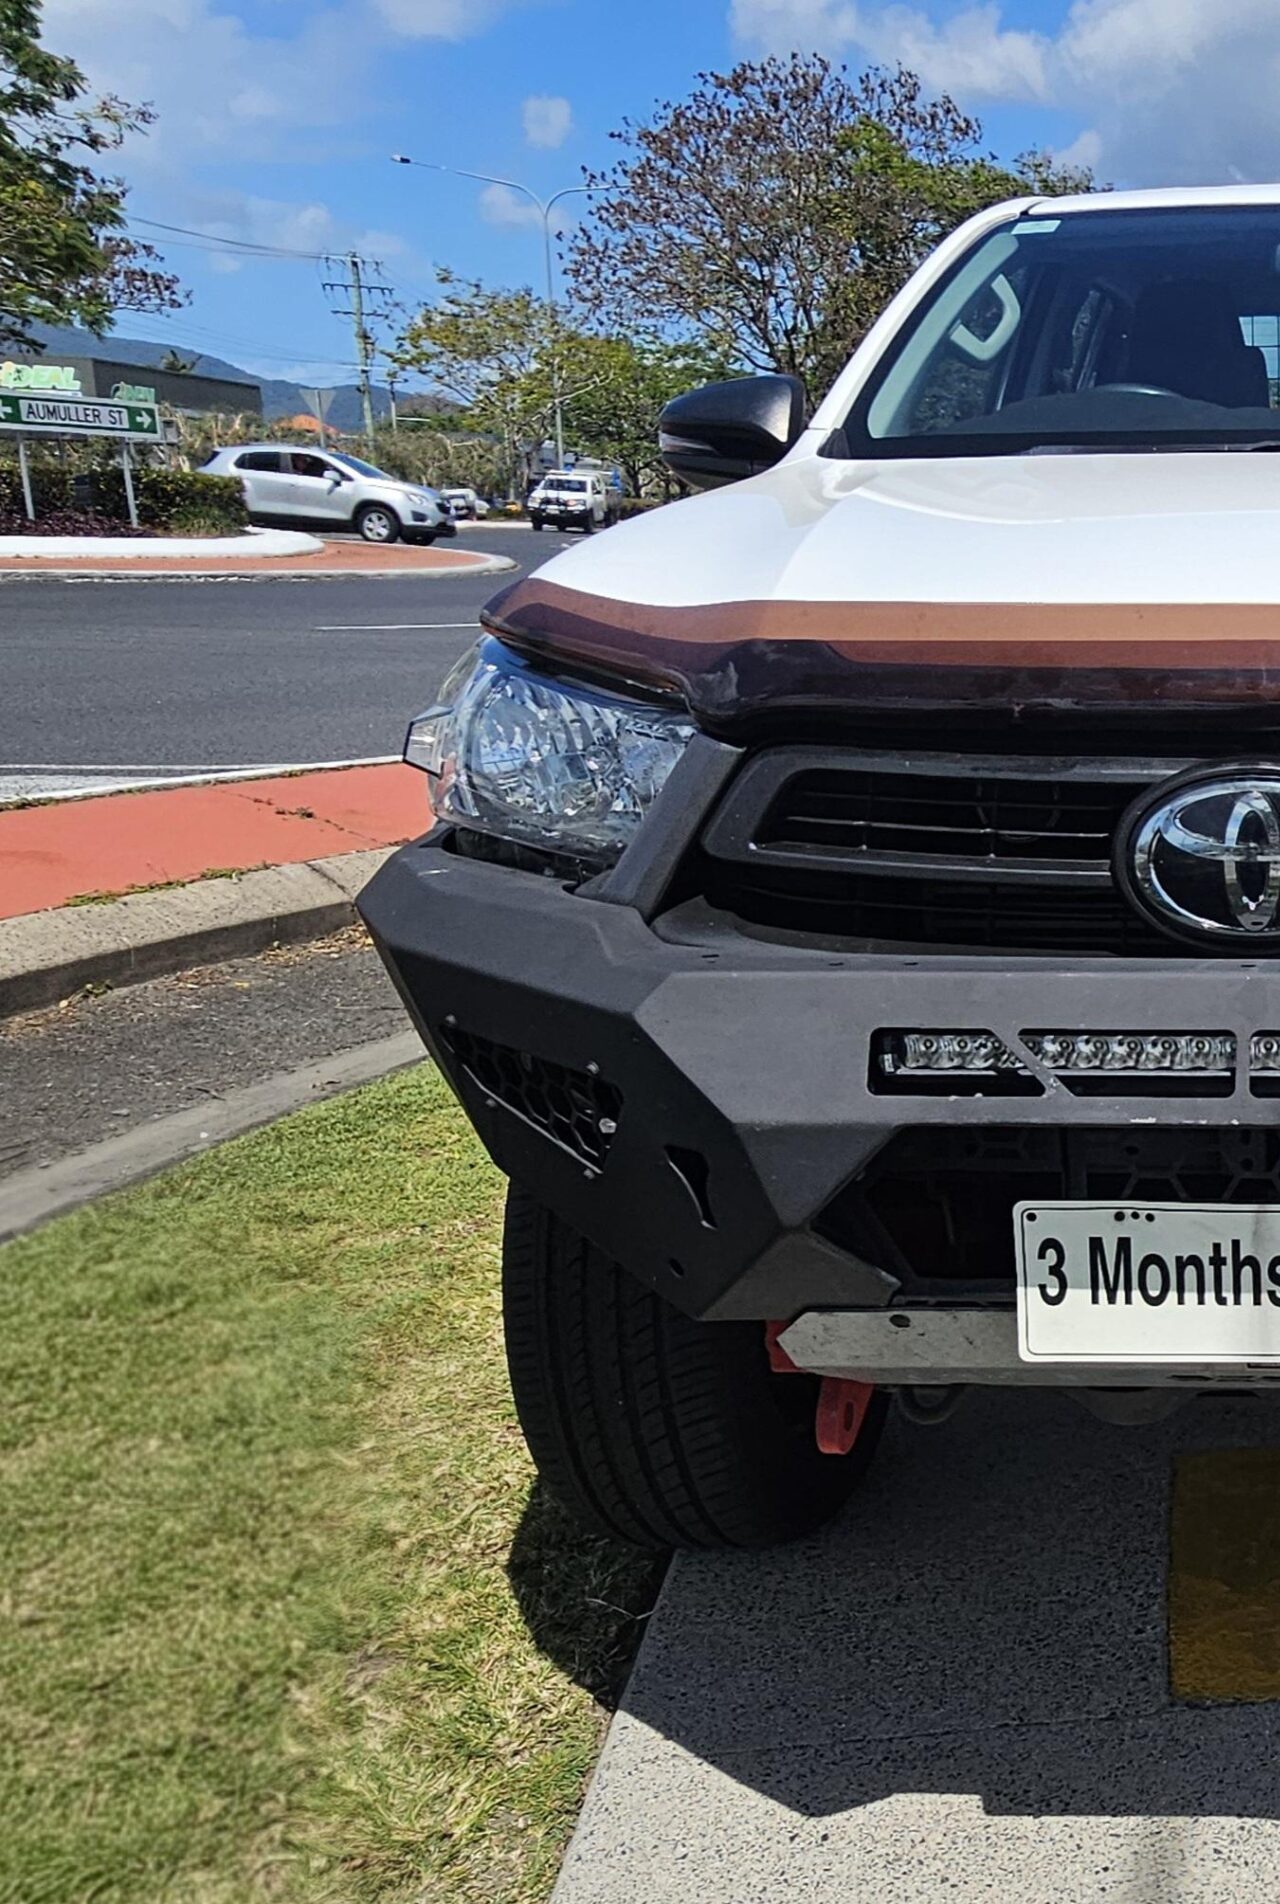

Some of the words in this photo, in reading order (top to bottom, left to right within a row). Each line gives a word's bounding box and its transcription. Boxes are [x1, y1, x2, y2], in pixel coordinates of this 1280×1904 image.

[26, 402, 102, 424] AUMULLER
[108, 409, 123, 425] ST
[1037, 1237, 1068, 1306] 3
